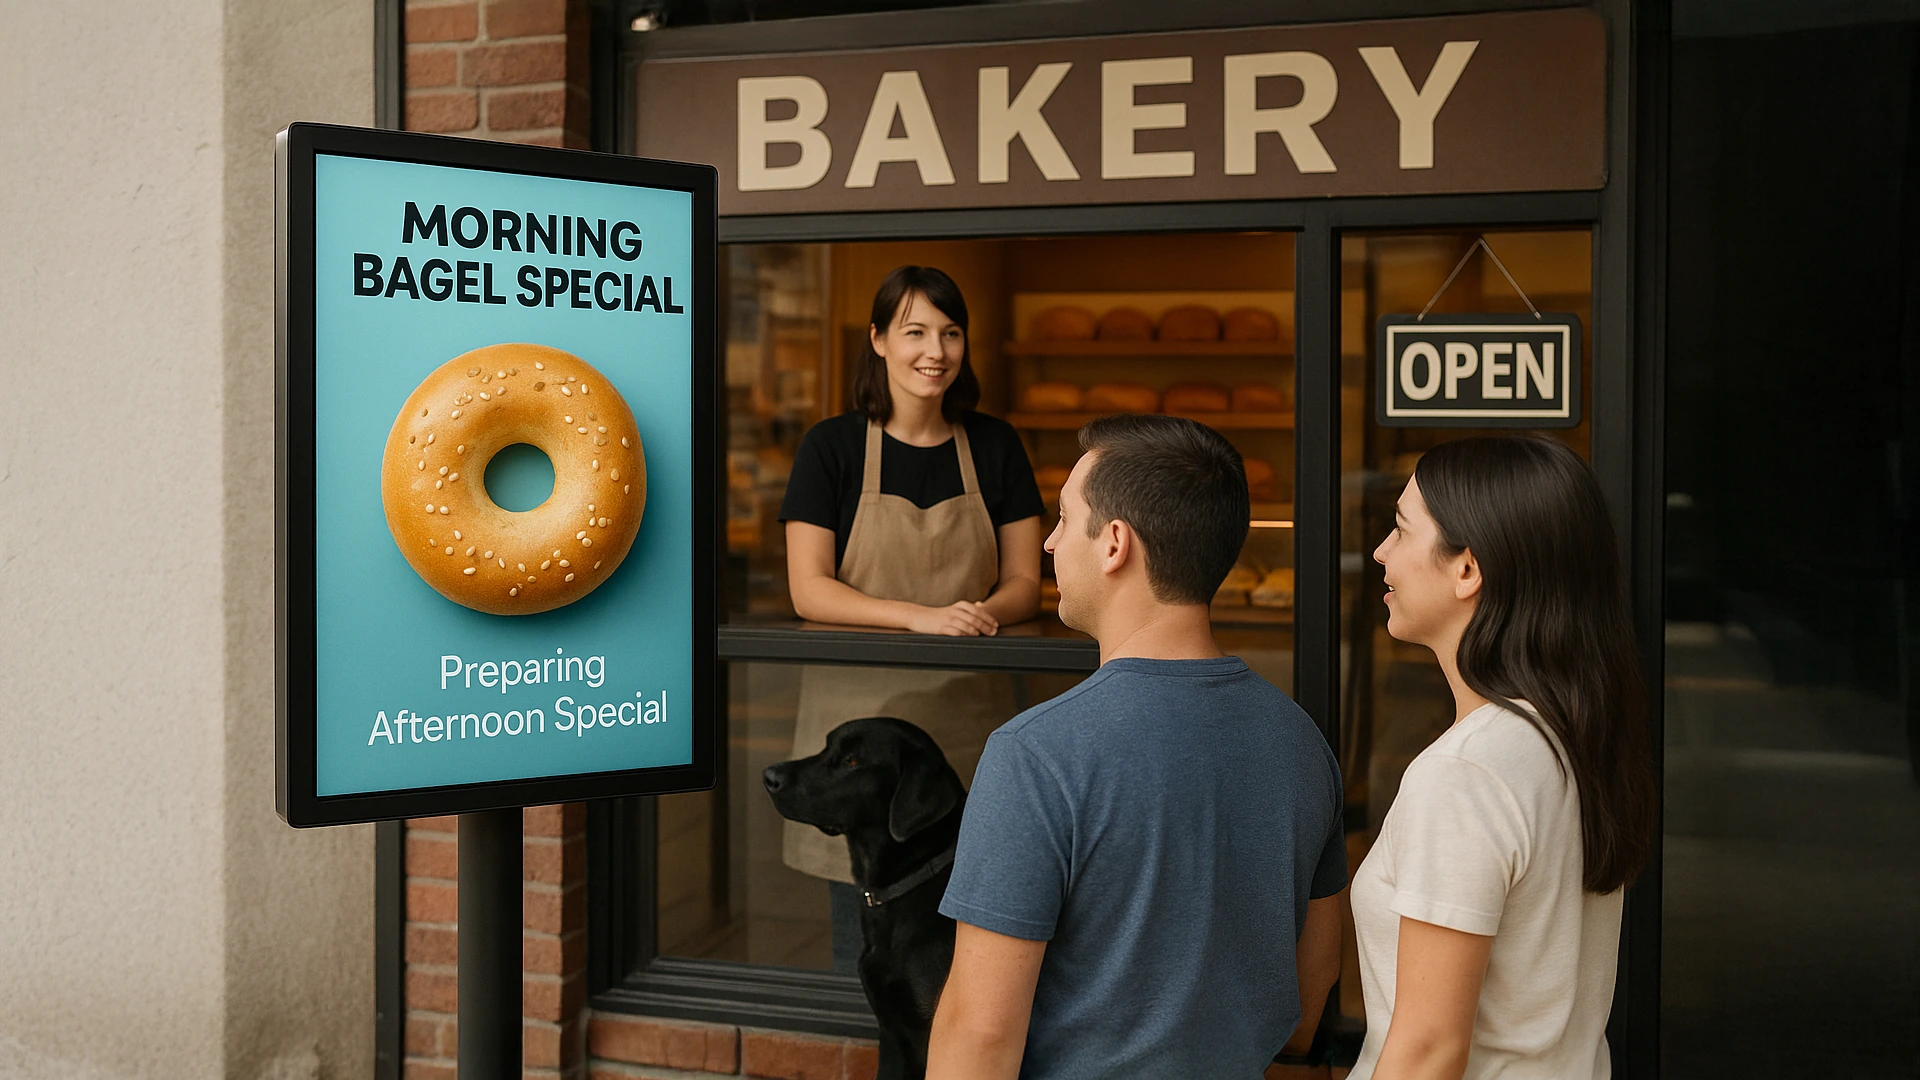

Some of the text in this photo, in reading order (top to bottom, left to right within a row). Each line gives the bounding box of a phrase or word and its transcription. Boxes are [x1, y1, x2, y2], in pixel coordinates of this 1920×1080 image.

[736, 41, 1479, 193] BAKERY
[401, 201, 642, 262] MORNING
[353, 252, 684, 315] BAGEL SPECIAL
[1399, 340, 1556, 402] OPEN
[440, 648, 606, 695] Preparing
[367, 690, 668, 746] Afternoon Special
